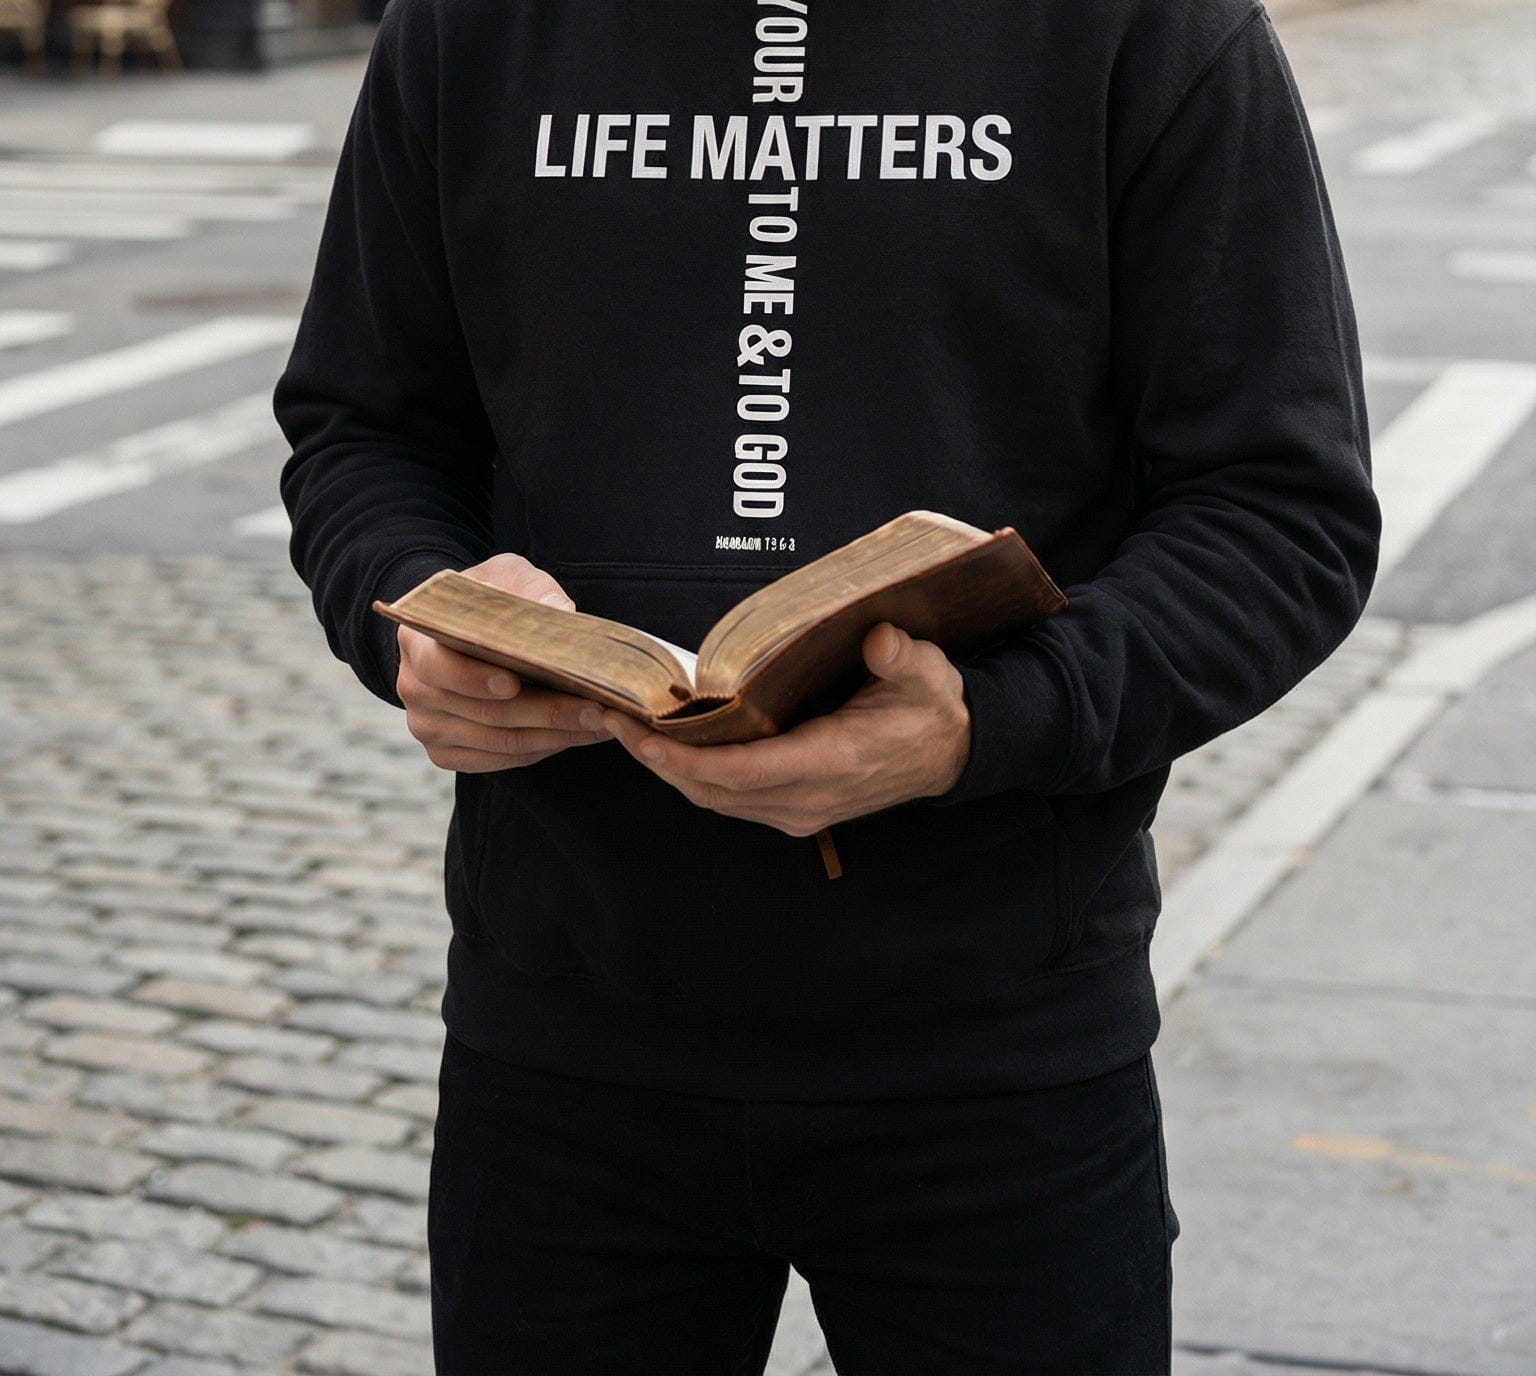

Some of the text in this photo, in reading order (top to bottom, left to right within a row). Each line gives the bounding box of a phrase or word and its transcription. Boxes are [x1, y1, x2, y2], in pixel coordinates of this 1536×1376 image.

[534, 113, 1013, 182] LIFE MATTERS
[748, 186, 800, 243] TO
[743, 254, 797, 315] ME
[732, 433, 789, 519] GOD
